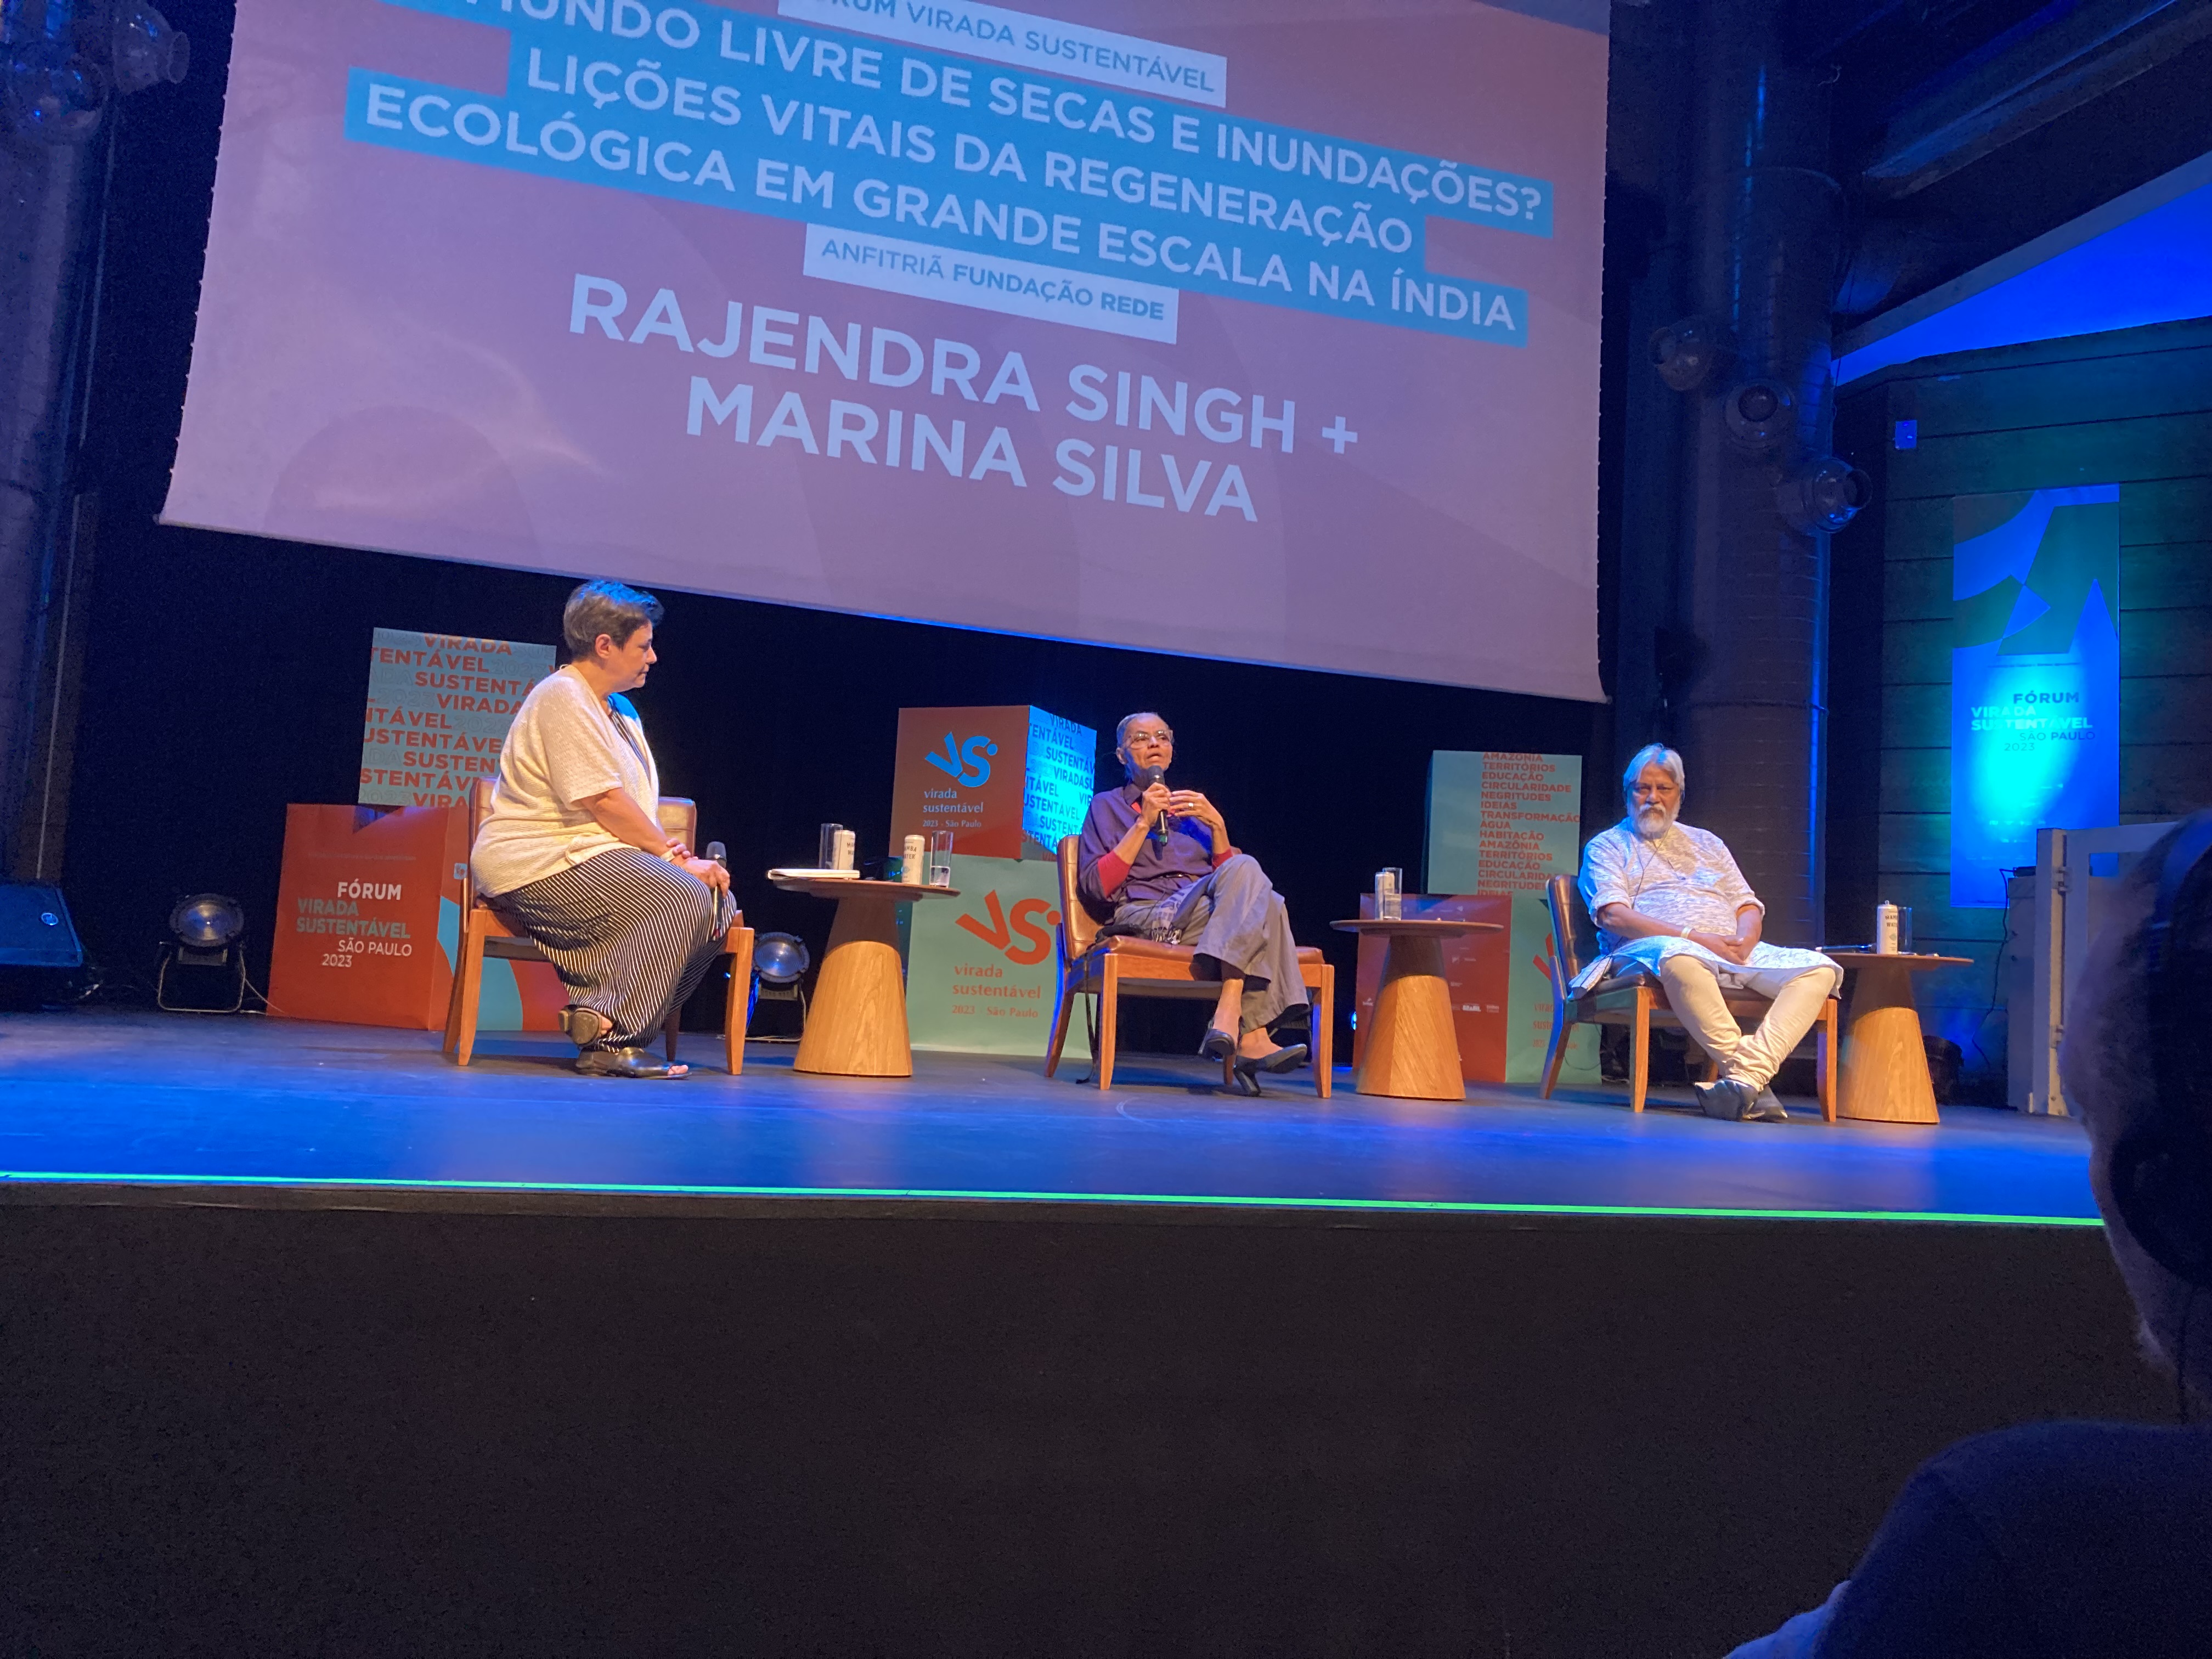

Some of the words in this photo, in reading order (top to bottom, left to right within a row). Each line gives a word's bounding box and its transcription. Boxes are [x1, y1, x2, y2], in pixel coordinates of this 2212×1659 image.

[817, 0, 896, 18] UM
[906, 2, 1015, 46] VIRADA
[1025, 30, 1214, 93] SUSTENTÁVEL
[466, 0, 700, 48] UNDO
[720, 19, 883, 89] LIVRE
[901, 58, 973, 108] DE
[989, 77, 1155, 143] SECAS
[1172, 115, 1200, 154] E
[1217, 124, 1542, 220] INUNDAÇÕES?
[528, 48, 741, 126] LIÇÕES
[762, 94, 935, 163] VITAIS
[955, 133, 1027, 182] DA
[1045, 151, 1412, 253] REGENERAÇÃO
[366, 83, 735, 192] ECOLÓGICA
[756, 158, 834, 210] EM
[854, 179, 1081, 253] GRANDE
[1098, 223, 1292, 291] ESCALA
[1310, 262, 1375, 307] NA
[1391, 269, 1516, 331] ÍNDIA
[821, 239, 945, 279] ANFITRIÃ
[953, 263, 1093, 307] FUNDAÇÃO
[1101, 292, 1164, 321] REDE
[569, 273, 1040, 411] RAJENDRA
[1065, 364, 1295, 453] SINGH
[1322, 416, 1358, 454] +
[687, 375, 1027, 488] MARINA
[1053, 438, 1258, 522] SILVA
[424, 633, 512, 656] VIRADA
[2013, 690, 2079, 704] FÓRUM
[1971, 706, 2036, 718] VIRADA
[1050, 714, 1082, 736] VIRADA
[2019, 731, 2046, 741] SÃO
[2051, 731, 2095, 741] PAULO
[2004, 743, 2035, 751] 2023
[403, 751, 500, 774] SUSTEN
[1482, 761, 1556, 772] TERRITÓRIOS
[360, 768, 479, 791] STENTÁV
[1482, 771, 1544, 781] EDUCAÇÃO
[924, 788, 957, 798] virada
[1481, 781, 1572, 792] CIRCULARIDADE
[1481, 792, 1551, 801] NEGRITUDES
[923, 802, 984, 813] sustentável
[1481, 801, 1517, 810] IDEIAS
[1480, 810, 1580, 822] TRANSFORMAÇÃO
[961, 820, 981, 828] Paulo
[1480, 820, 1511, 829] ÁGUA
[1480, 830, 1544, 841] HABITAÇÃO
[1479, 839, 1540, 850] AMAZÔNIA
[1479, 849, 1553, 861] TERRITÓRIOS
[1479, 859, 1541, 871] EDUCAÇÃO
[1478, 870, 1560, 881] CIRCULARIDA
[338, 878, 402, 900] FÓRUM
[298, 897, 359, 916] VIRADA
[297, 917, 410, 939] SUSTENTÁVEL
[338, 937, 364, 953] SÃO
[368, 941, 412, 956] PAULO
[322, 953, 353, 968] 2023
[954, 964, 1003, 978] virada
[952, 984, 1041, 999] sustentável
[952, 1005, 975, 1015] 2023
[986, 1006, 1006, 1017] São
[1009, 1008, 1039, 1018] Paulo
